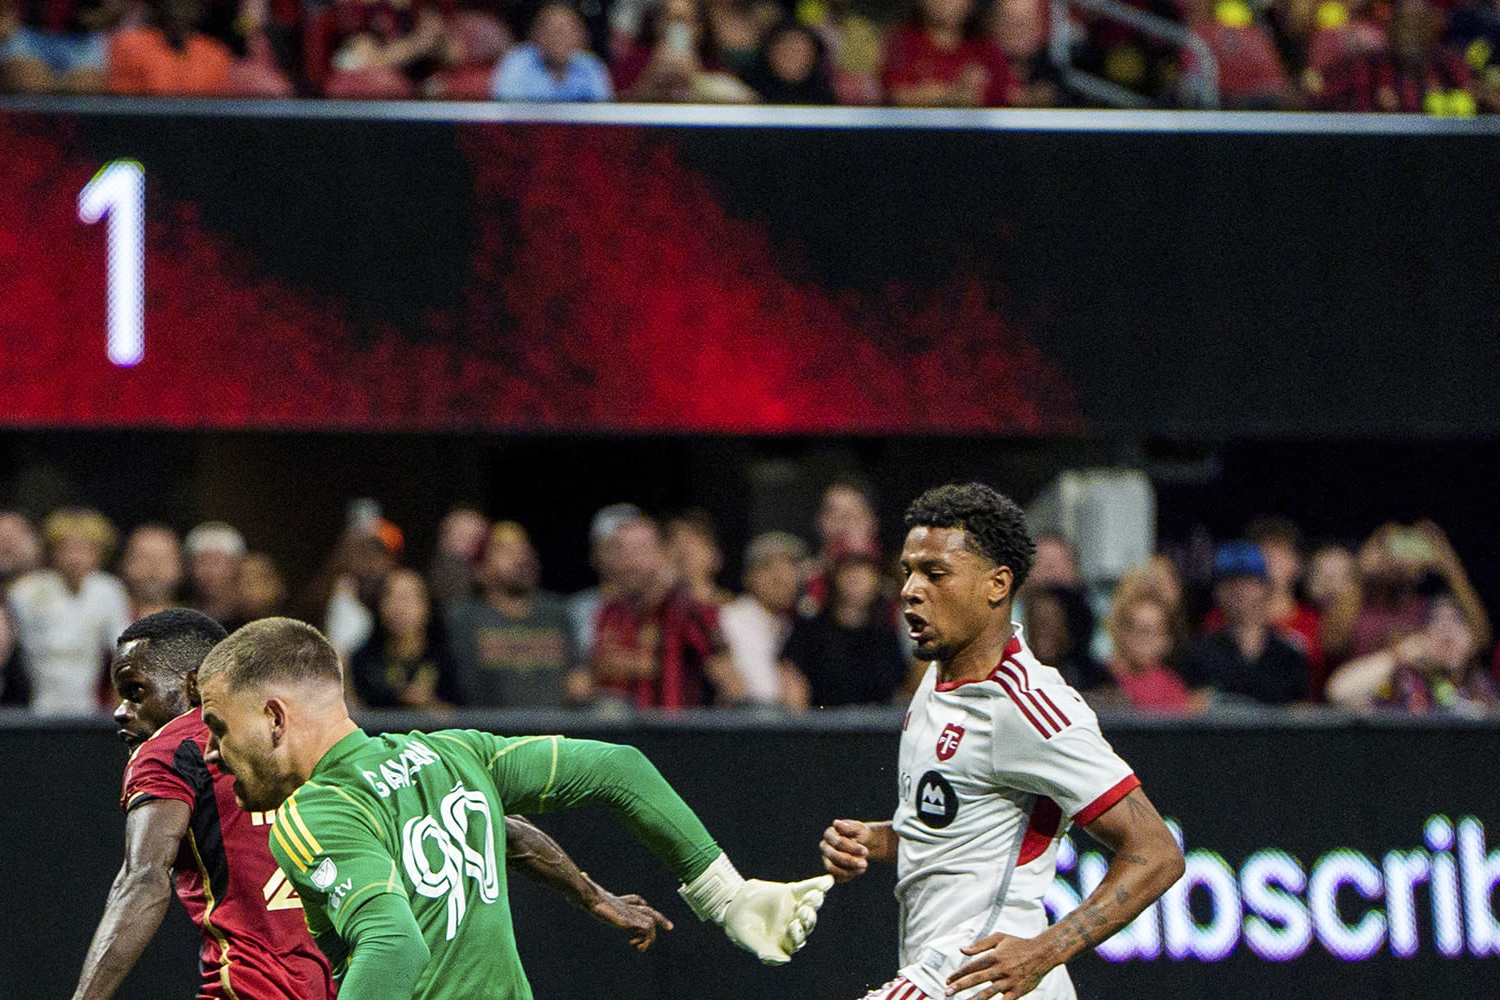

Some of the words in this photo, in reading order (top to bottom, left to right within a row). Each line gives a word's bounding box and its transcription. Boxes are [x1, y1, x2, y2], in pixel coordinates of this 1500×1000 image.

[76, 158, 146, 368] 1
[362, 740, 441, 798] GAVAN
[403, 781, 499, 941] 90
